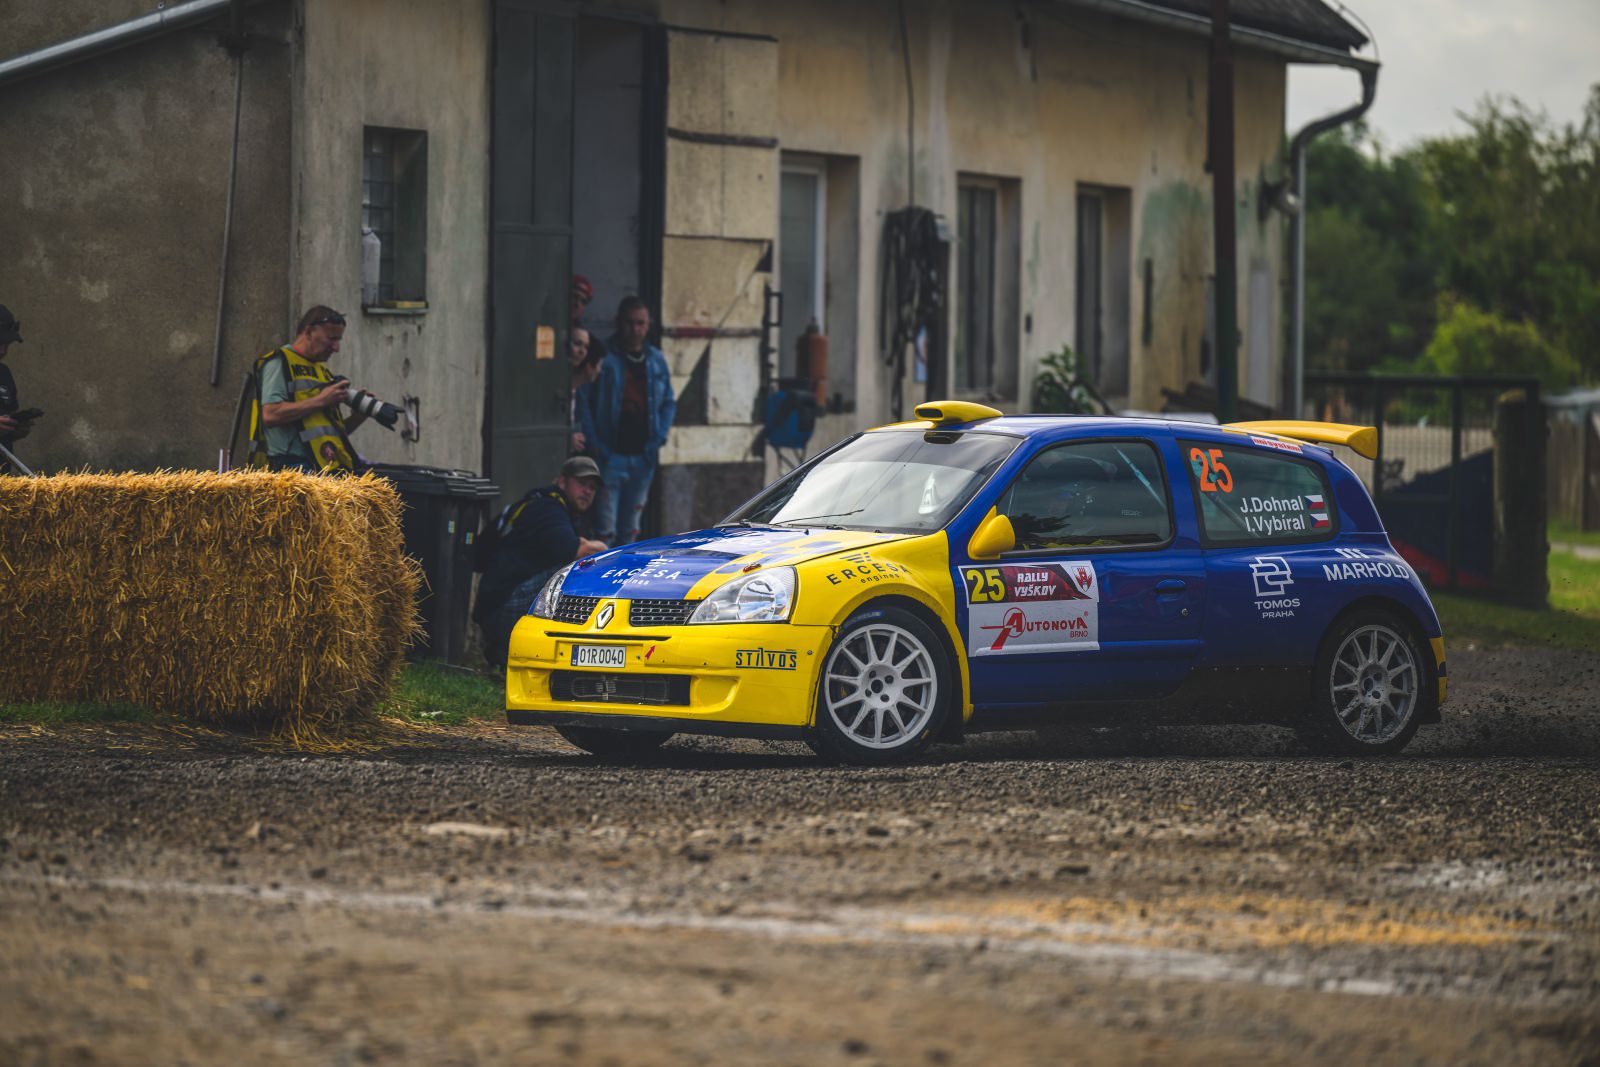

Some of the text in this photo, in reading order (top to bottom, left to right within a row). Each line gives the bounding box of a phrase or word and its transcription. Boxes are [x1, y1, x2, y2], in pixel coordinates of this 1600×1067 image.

[1190, 448, 1233, 493] 25
[1240, 496, 1304, 513] J.Dohnal
[1244, 514, 1305, 535] I.Vybíral
[600, 568, 681, 580] ERCESA
[826, 562, 912, 585] ERCESA
[860, 573, 900, 583] engines
[1017, 572, 1048, 583] RALLY
[1322, 562, 1410, 581] MARHOLD
[612, 577, 650, 585] engines
[966, 569, 1005, 602] 25
[1014, 584, 1056, 597] VYŠKOV
[1254, 598, 1300, 610] TOMOS
[1262, 610, 1295, 618] PRAHA
[985, 611, 1088, 650] AUTONOVA
[1070, 630, 1088, 638] BRNO
[579, 648, 625, 665] 01R 0040
